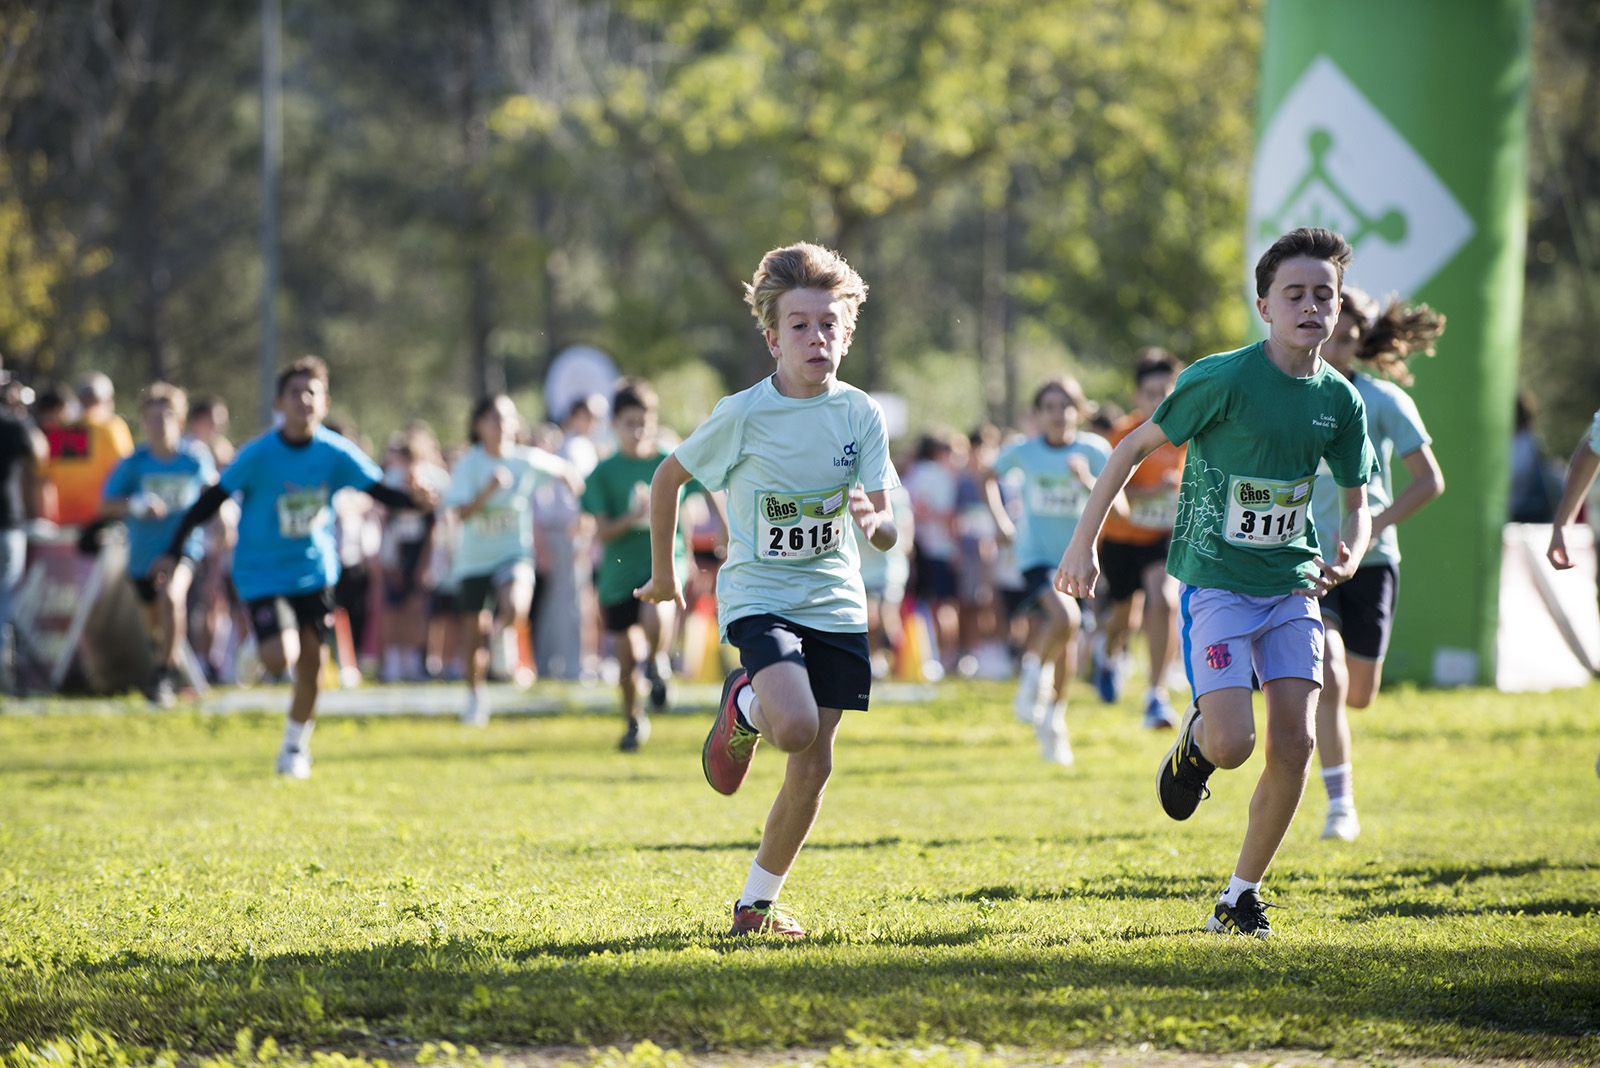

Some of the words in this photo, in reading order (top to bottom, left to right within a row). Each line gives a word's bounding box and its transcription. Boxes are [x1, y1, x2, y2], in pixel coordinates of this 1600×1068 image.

[1240, 489, 1271, 502] CROS
[767, 502, 798, 518] CROS
[1240, 510, 1297, 536] 3114
[769, 521, 833, 550] 2615
